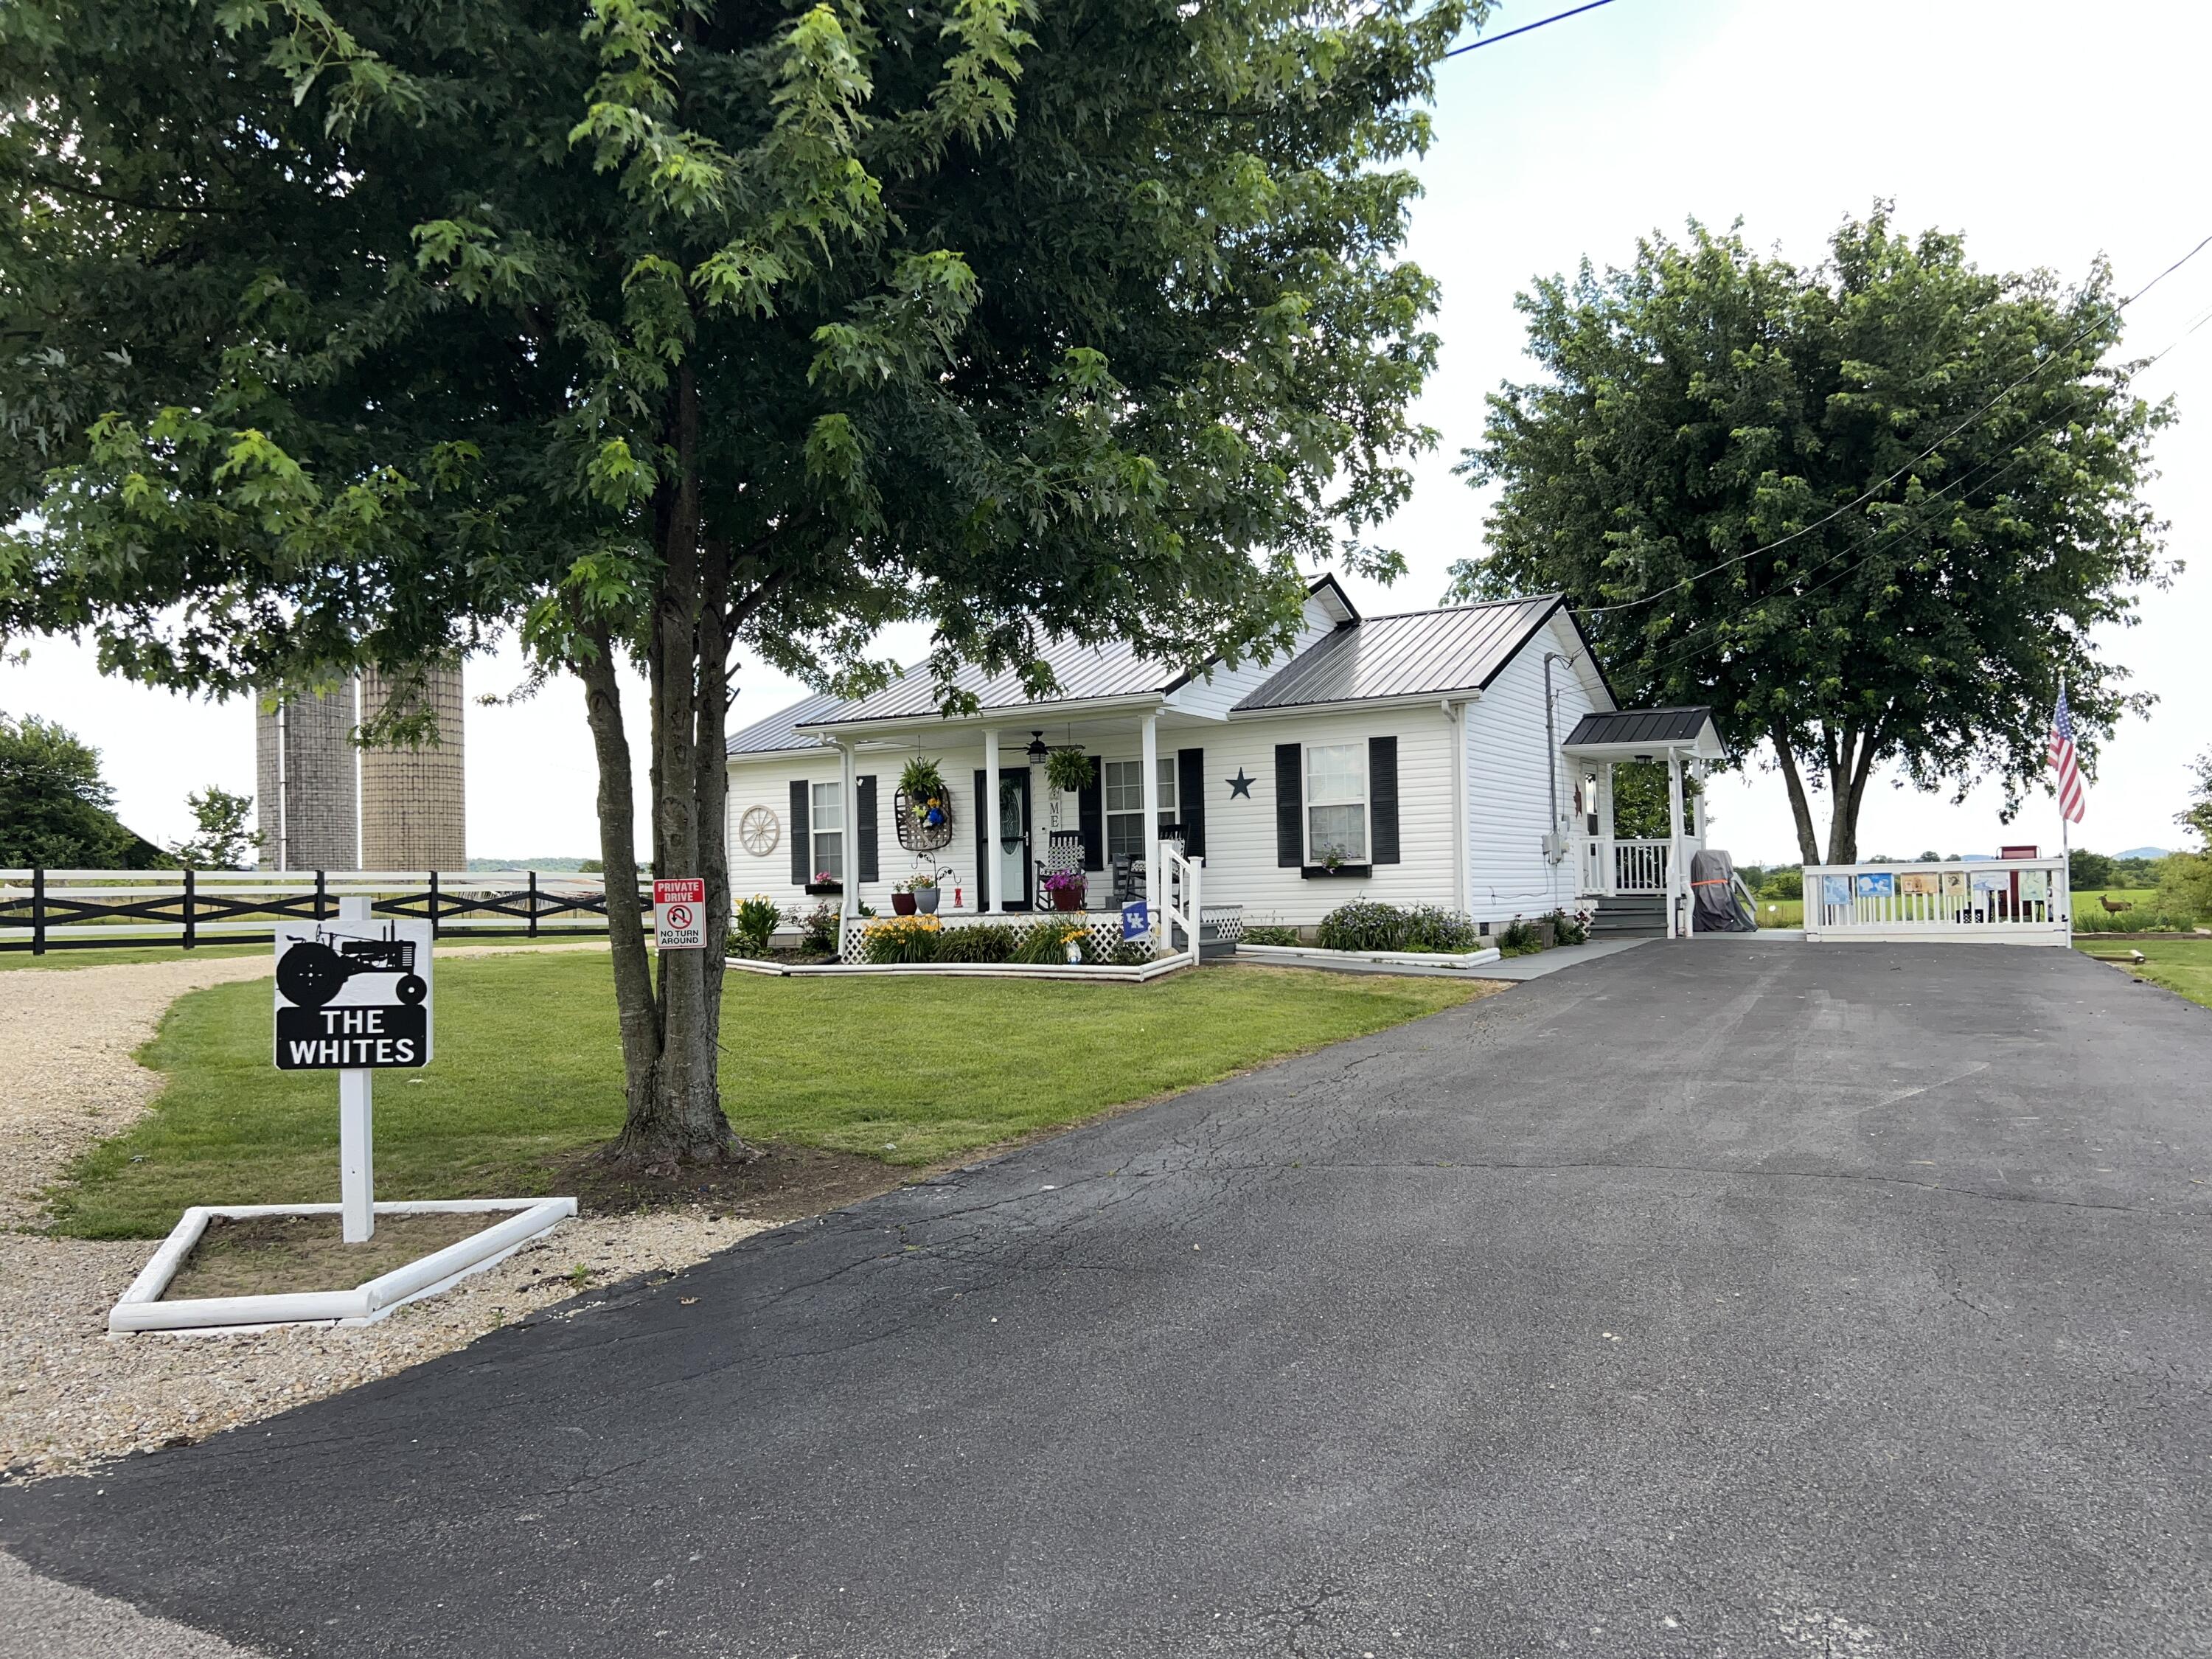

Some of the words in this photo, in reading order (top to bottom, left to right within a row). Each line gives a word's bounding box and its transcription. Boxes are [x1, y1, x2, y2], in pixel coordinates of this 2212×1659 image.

[658, 882, 700, 892] PRIVATE
[664, 892, 694, 902] DRIVE
[1126, 912, 1145, 929] UK
[319, 1009, 385, 1034] THE
[289, 1038, 414, 1065] WHITES
